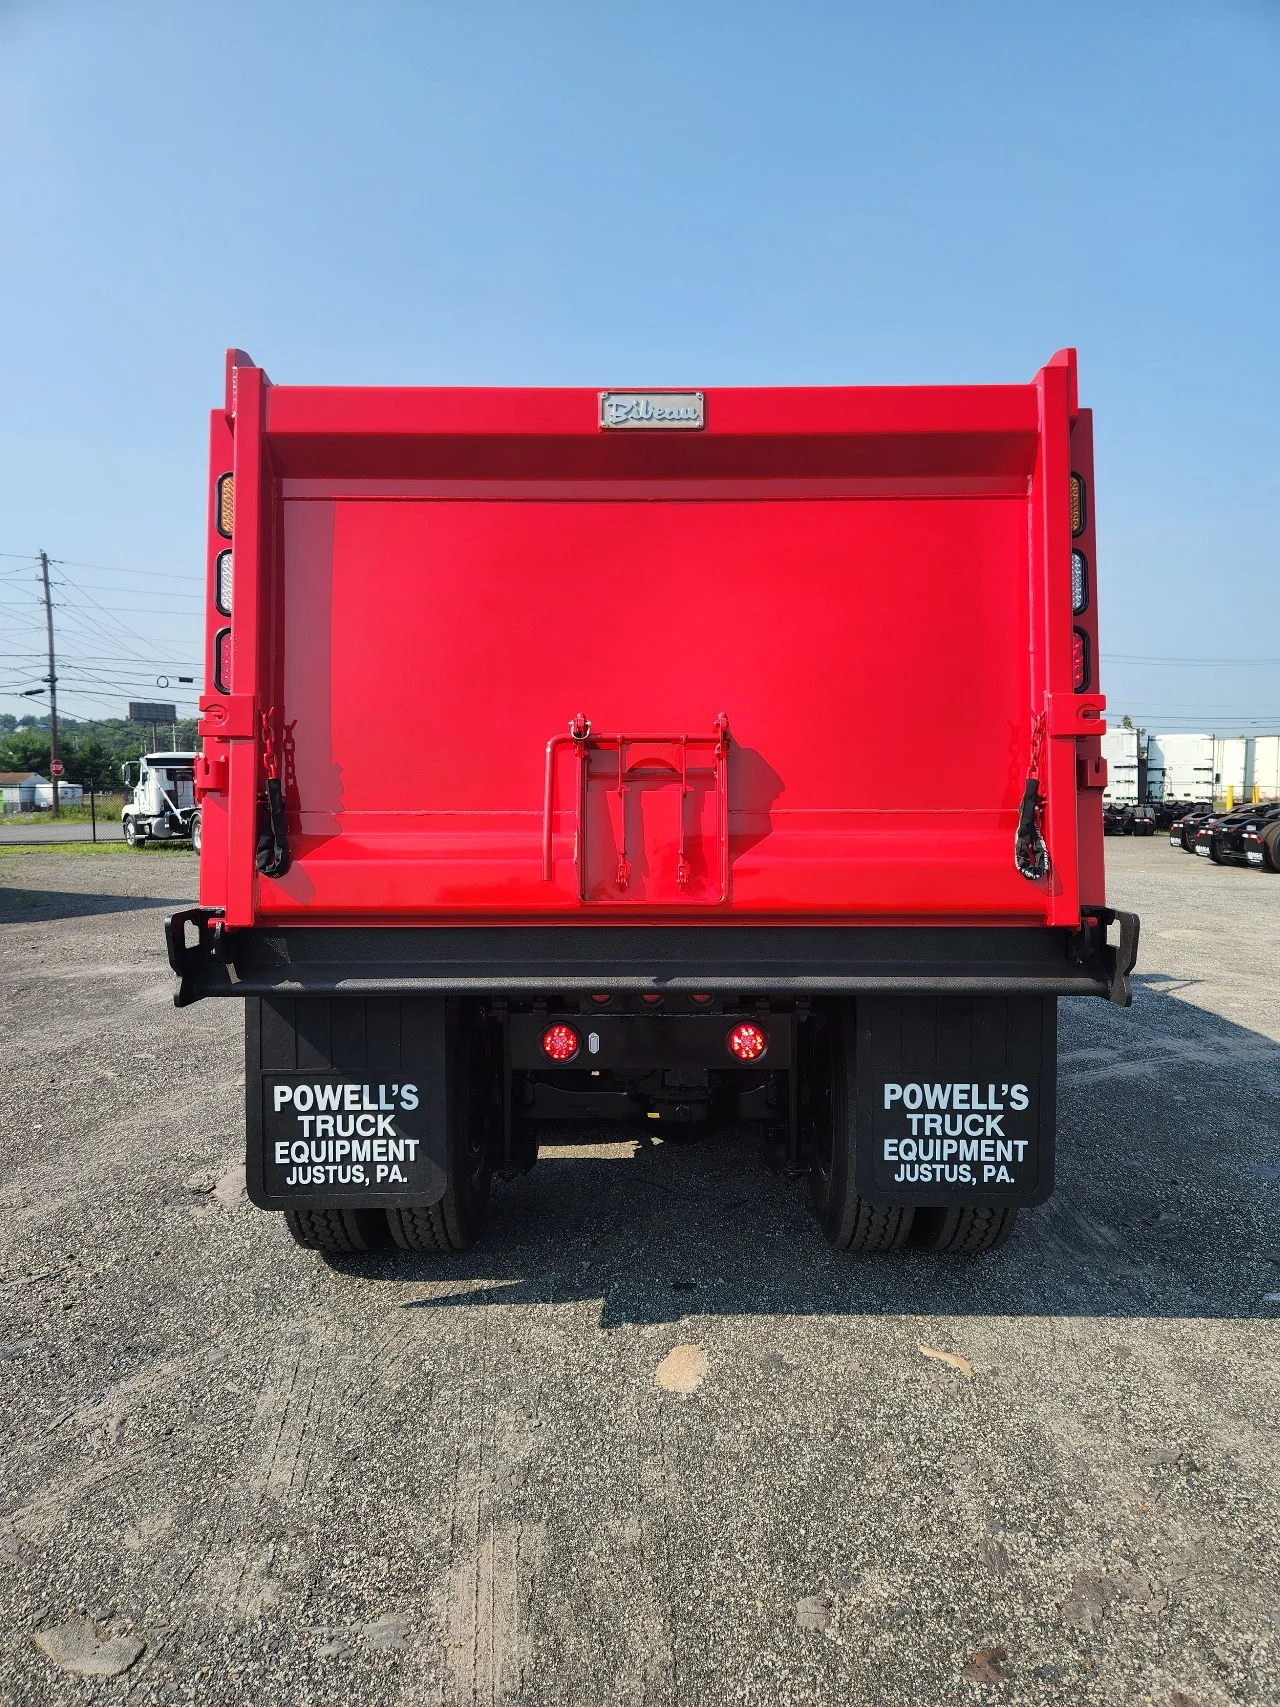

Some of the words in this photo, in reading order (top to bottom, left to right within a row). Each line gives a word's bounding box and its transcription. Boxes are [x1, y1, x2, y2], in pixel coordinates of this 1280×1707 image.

[607, 397, 700, 424] Bibeau
[274, 1084, 419, 1112] POWELL'S
[884, 1083, 1029, 1111] POWELL'S
[297, 1114, 397, 1138] TRUCK
[906, 1113, 1006, 1137] TRUCK
[274, 1139, 420, 1164] EQUIPMENT
[883, 1138, 1029, 1162] EQUIPMENT
[286, 1165, 370, 1186] JUSTUS,
[376, 1164, 408, 1183] PA.
[894, 1163, 977, 1186] JUSTUS,
[983, 1164, 1015, 1183] PA.
